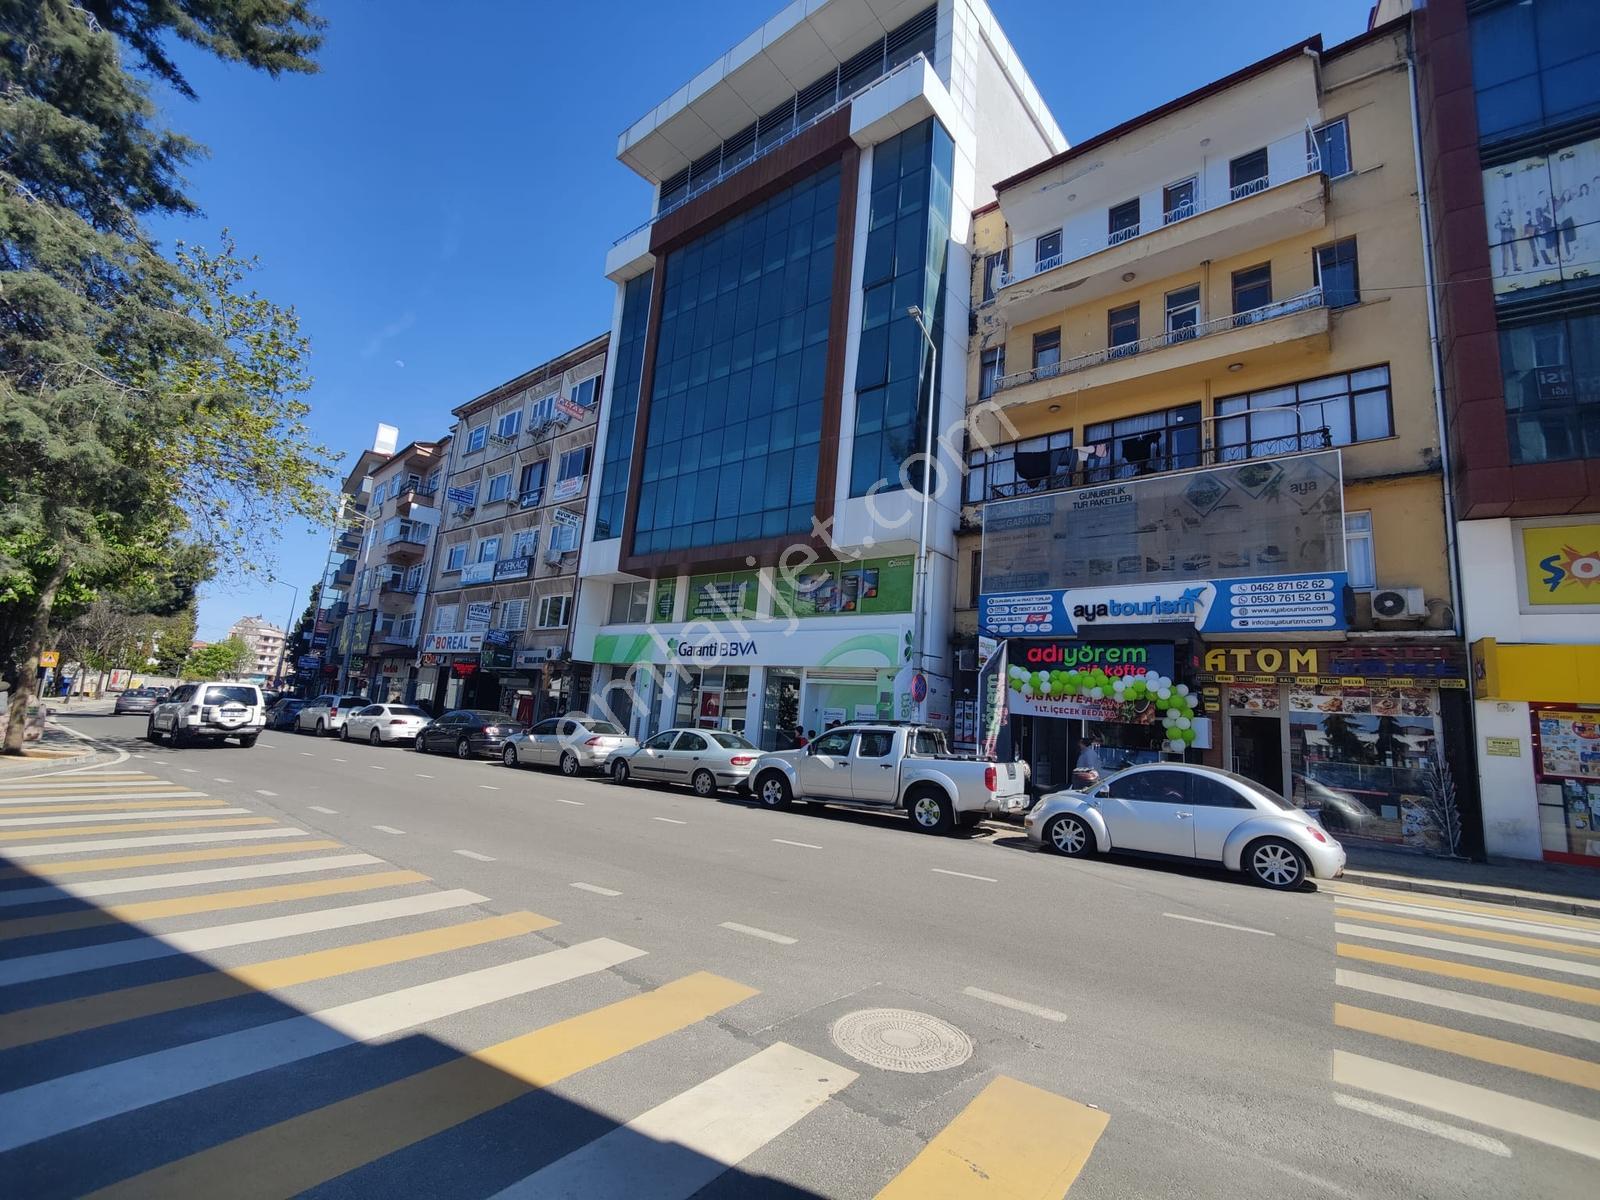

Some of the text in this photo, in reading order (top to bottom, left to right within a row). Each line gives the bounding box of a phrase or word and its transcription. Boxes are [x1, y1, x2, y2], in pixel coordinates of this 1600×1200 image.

[1290, 480, 1317, 495] aya
[1072, 500, 1088, 509] TUR
[1250, 580, 1325, 592] 0462 871 62 62
[1251, 592, 1326, 603] 0530 761 52 61
[1073, 596, 1195, 622] ayatourism
[1251, 605, 1329, 614] www.ayatourism.com
[435, 636, 469, 650] BOREAL
[679, 641, 758, 657] Garanti BBVA
[1027, 644, 1147, 666] adıyörem
[1205, 648, 1318, 673] ATOM
[1104, 664, 1147, 677] köfte
[1050, 705, 1080, 715] İÇECEK
